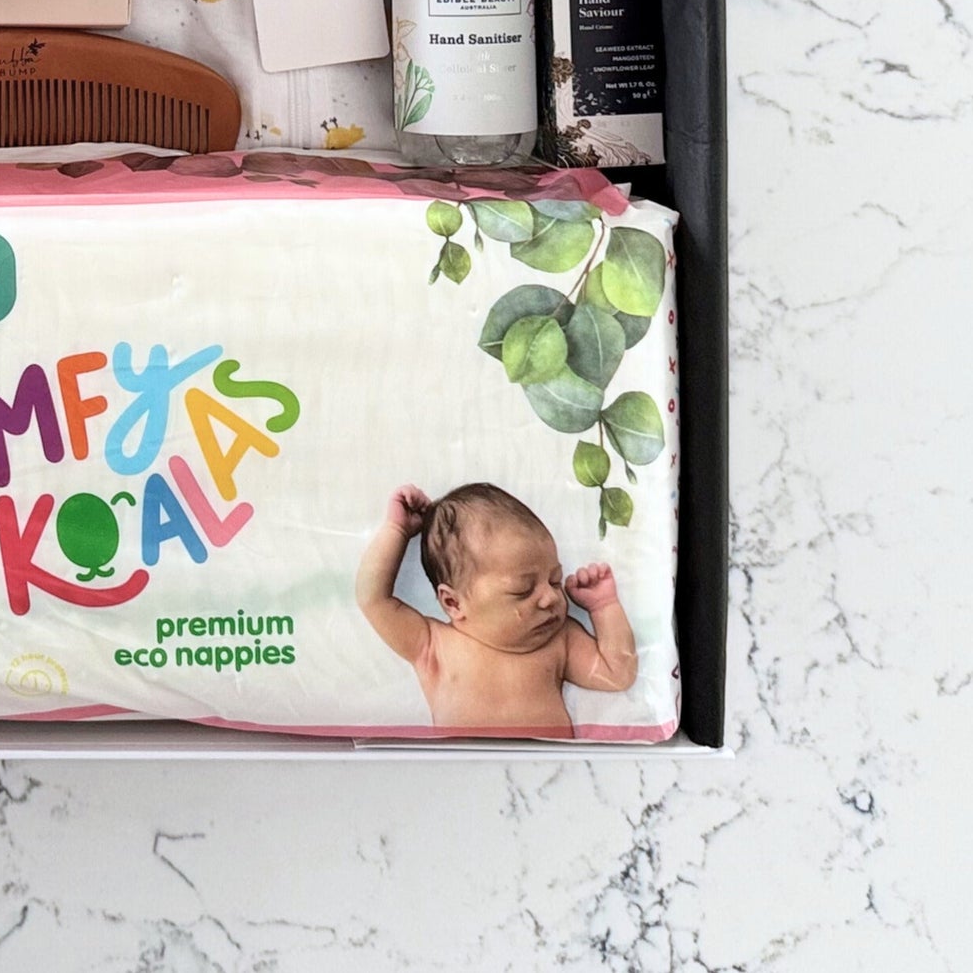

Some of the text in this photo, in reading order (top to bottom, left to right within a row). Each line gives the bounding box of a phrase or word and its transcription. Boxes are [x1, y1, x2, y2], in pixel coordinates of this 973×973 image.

[579, 7, 625, 18] Saviour
[429, 31, 522, 45] Hand Sanitiser
[595, 44, 654, 53] SEAWEED EXTRACT
[612, 54, 655, 62] MANGOSTEEN
[0, 67, 37, 77] BUMP
[593, 65, 638, 73] SNOWFLOWER
[156, 610, 294, 644] premium
[114, 639, 296, 672] eco nappies
